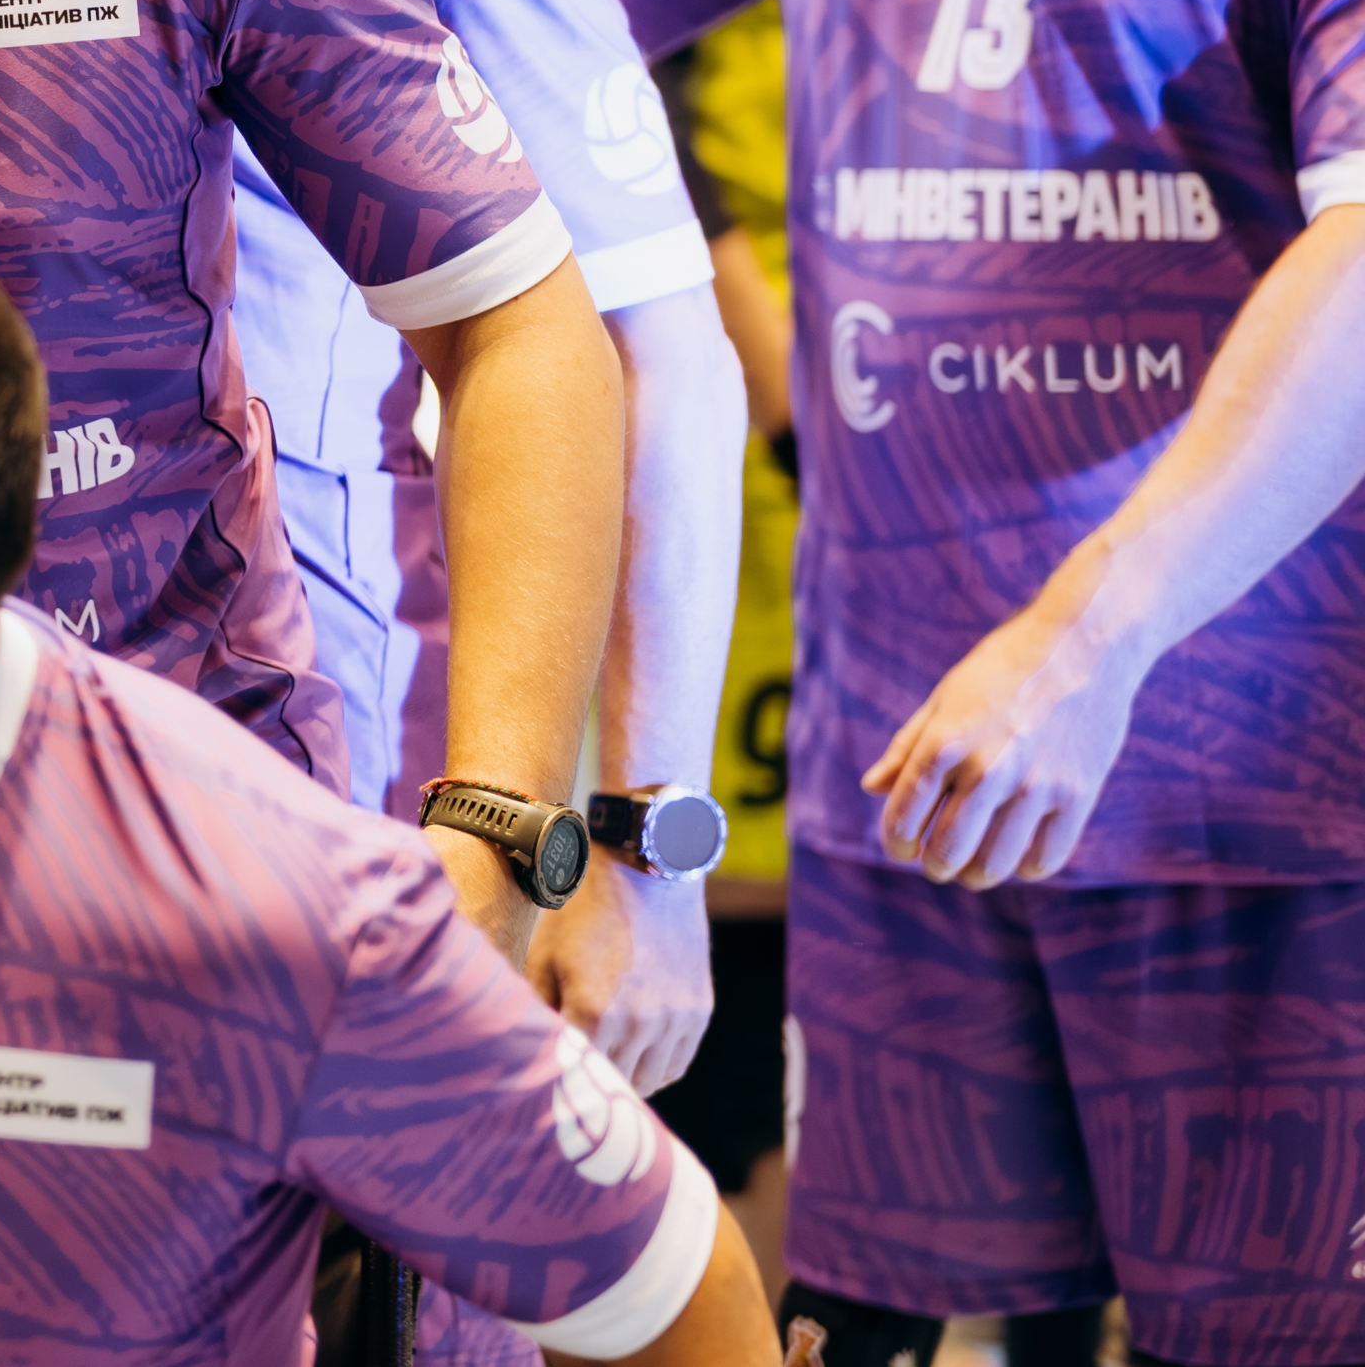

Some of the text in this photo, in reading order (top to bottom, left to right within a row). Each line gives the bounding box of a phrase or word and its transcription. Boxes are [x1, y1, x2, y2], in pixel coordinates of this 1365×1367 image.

[87, 5, 120, 22] ПЖ
[834, 167, 1222, 242] МІНВЕТЕРАНІВ
[928, 341, 1183, 395] CIKLUM
